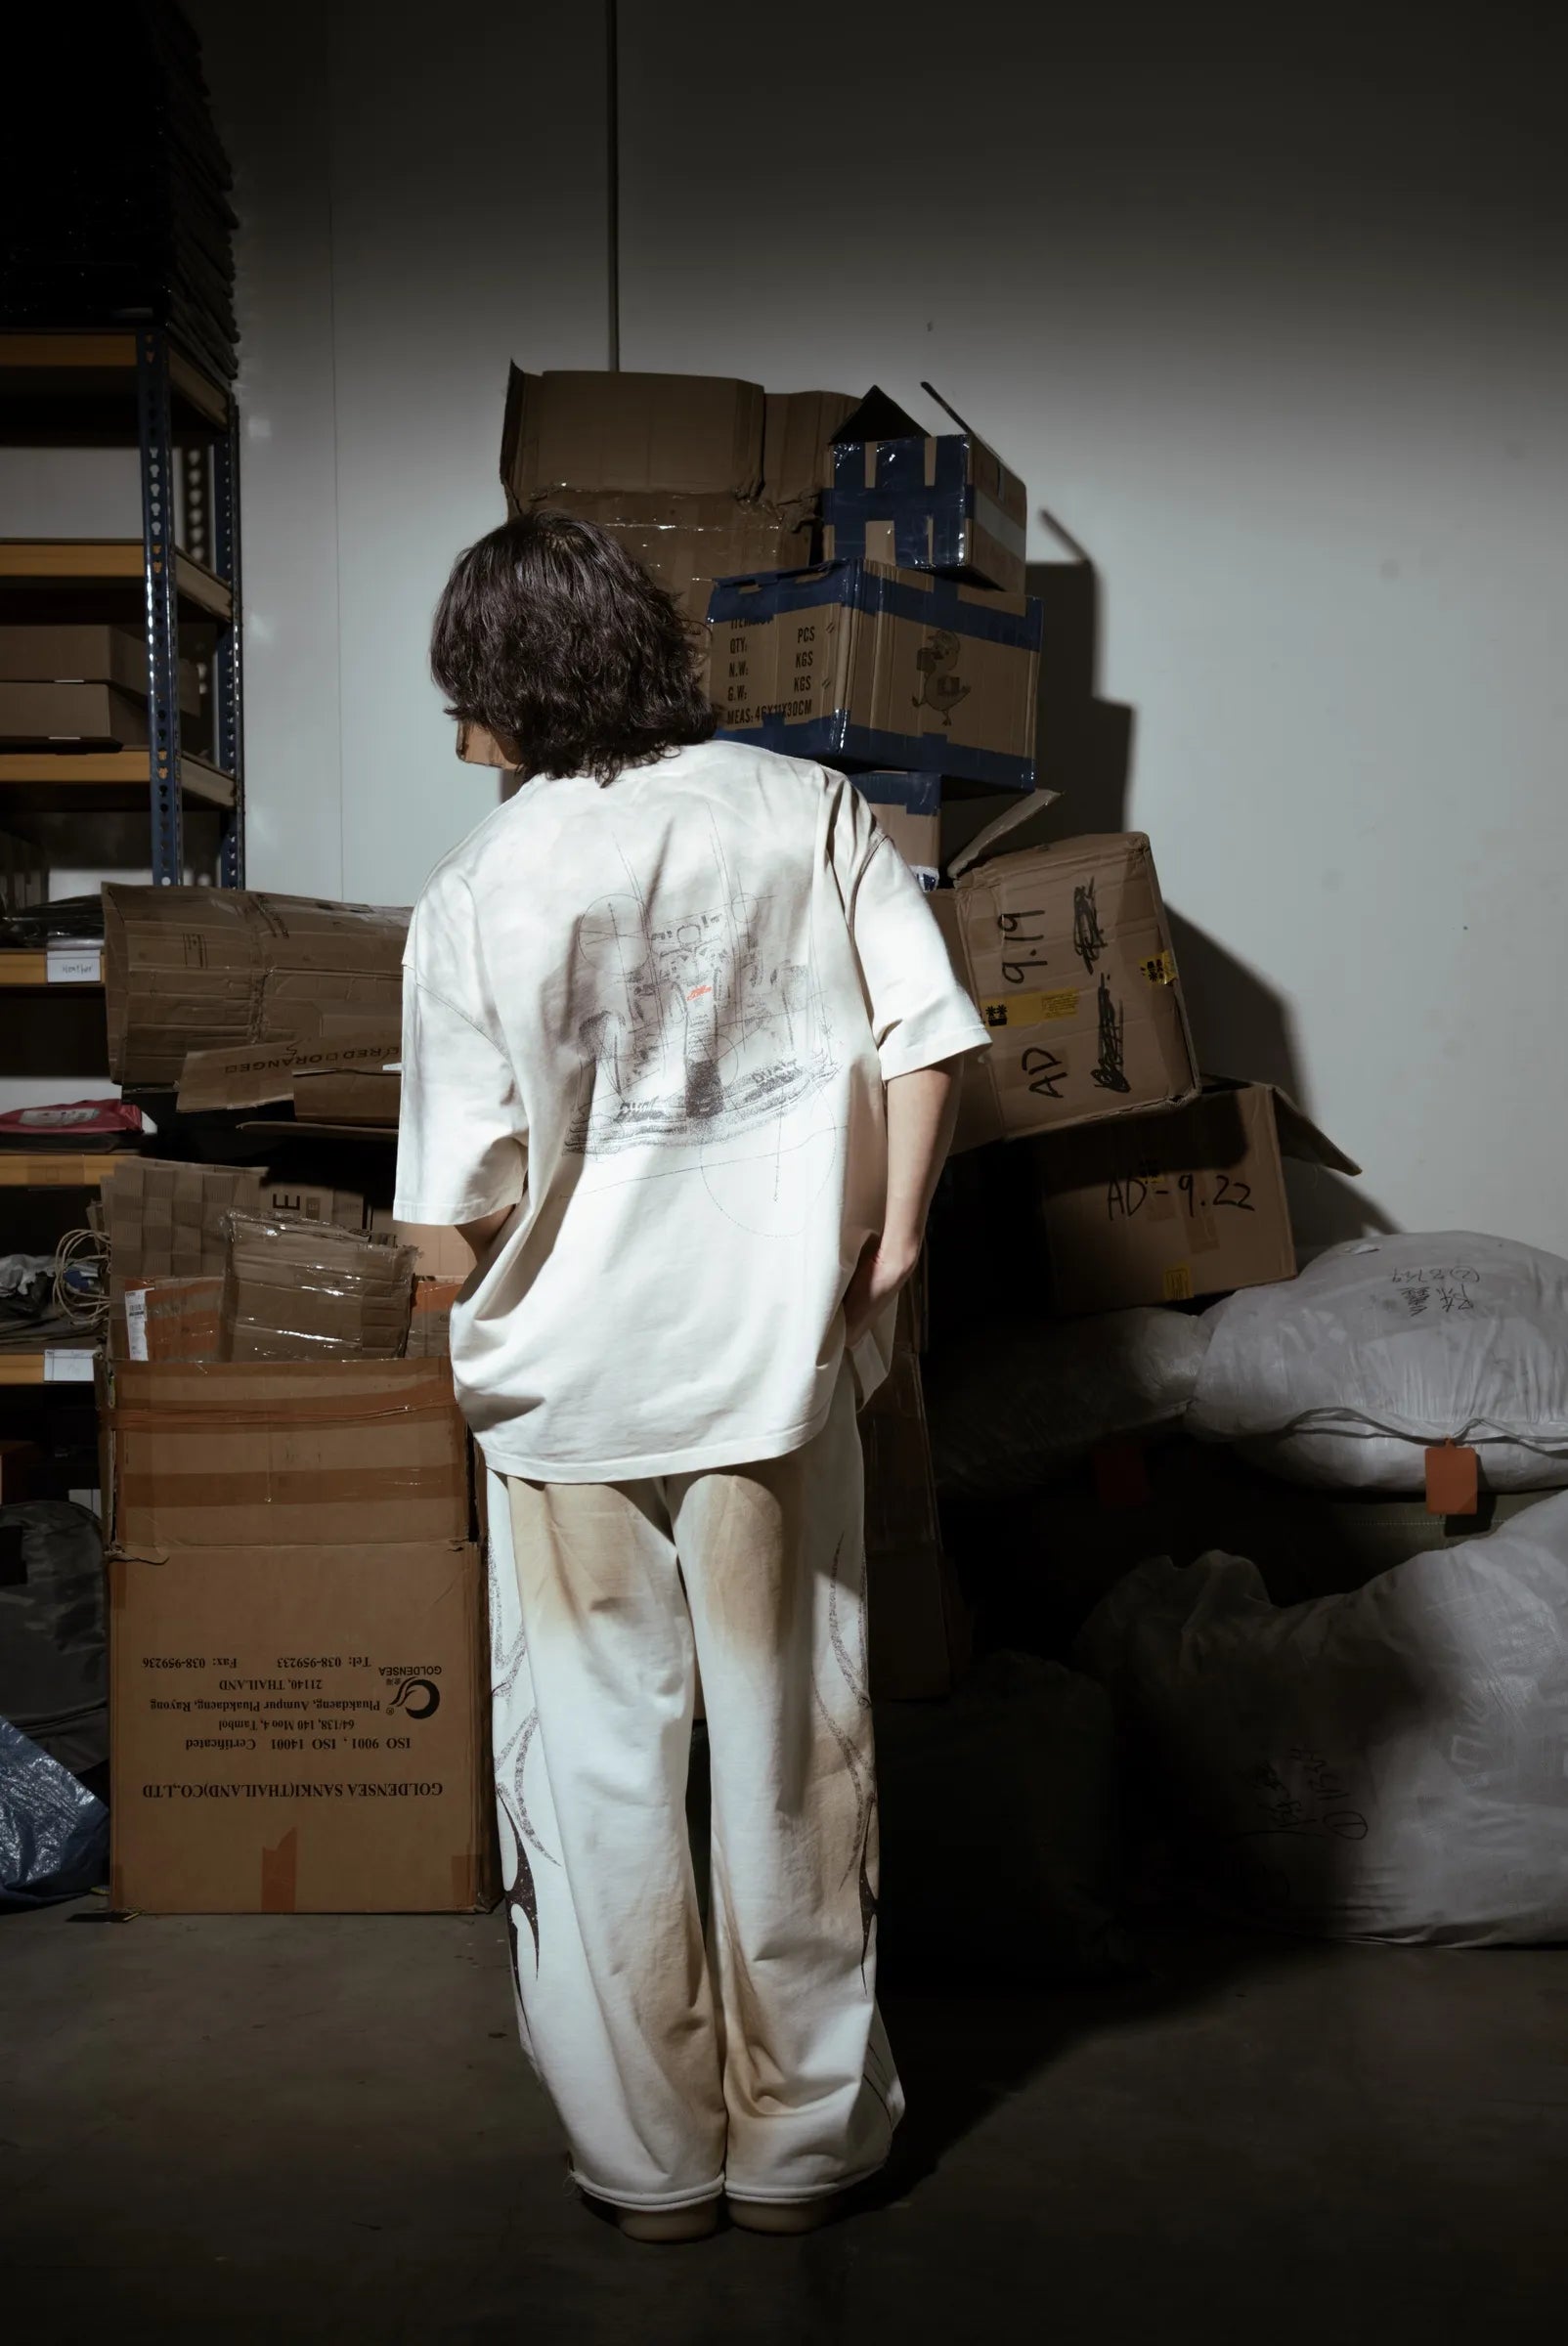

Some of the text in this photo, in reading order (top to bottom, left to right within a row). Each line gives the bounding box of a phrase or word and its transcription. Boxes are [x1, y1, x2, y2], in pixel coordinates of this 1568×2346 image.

[798, 627, 815, 644] PCS
[795, 651, 813, 669] KGS
[793, 675, 811, 693] KGS
[998, 910, 1048, 984] 9.19
[1022, 1047, 1068, 1099] AD
[142, 1656, 371, 1669] Tel: 038-959233 Fax: 038-959236
[378, 1666, 442, 1676] GOLDENSEA
[219, 1679, 285, 1691] THAILAND
[151, 1699, 191, 1712] Rayong
[264, 1698, 309, 1712] Aumpur
[313, 1698, 380, 1712] Pluakdaeng,
[219, 1719, 258, 1731] Tambol
[297, 1719, 315, 1730] 140
[186, 1738, 256, 1751] Certificated
[271, 1738, 304, 1750] 14001
[313, 1738, 337, 1750] ISO
[386, 1738, 411, 1750] ISO
[347, 1783, 443, 1797] GOLDENSEA
